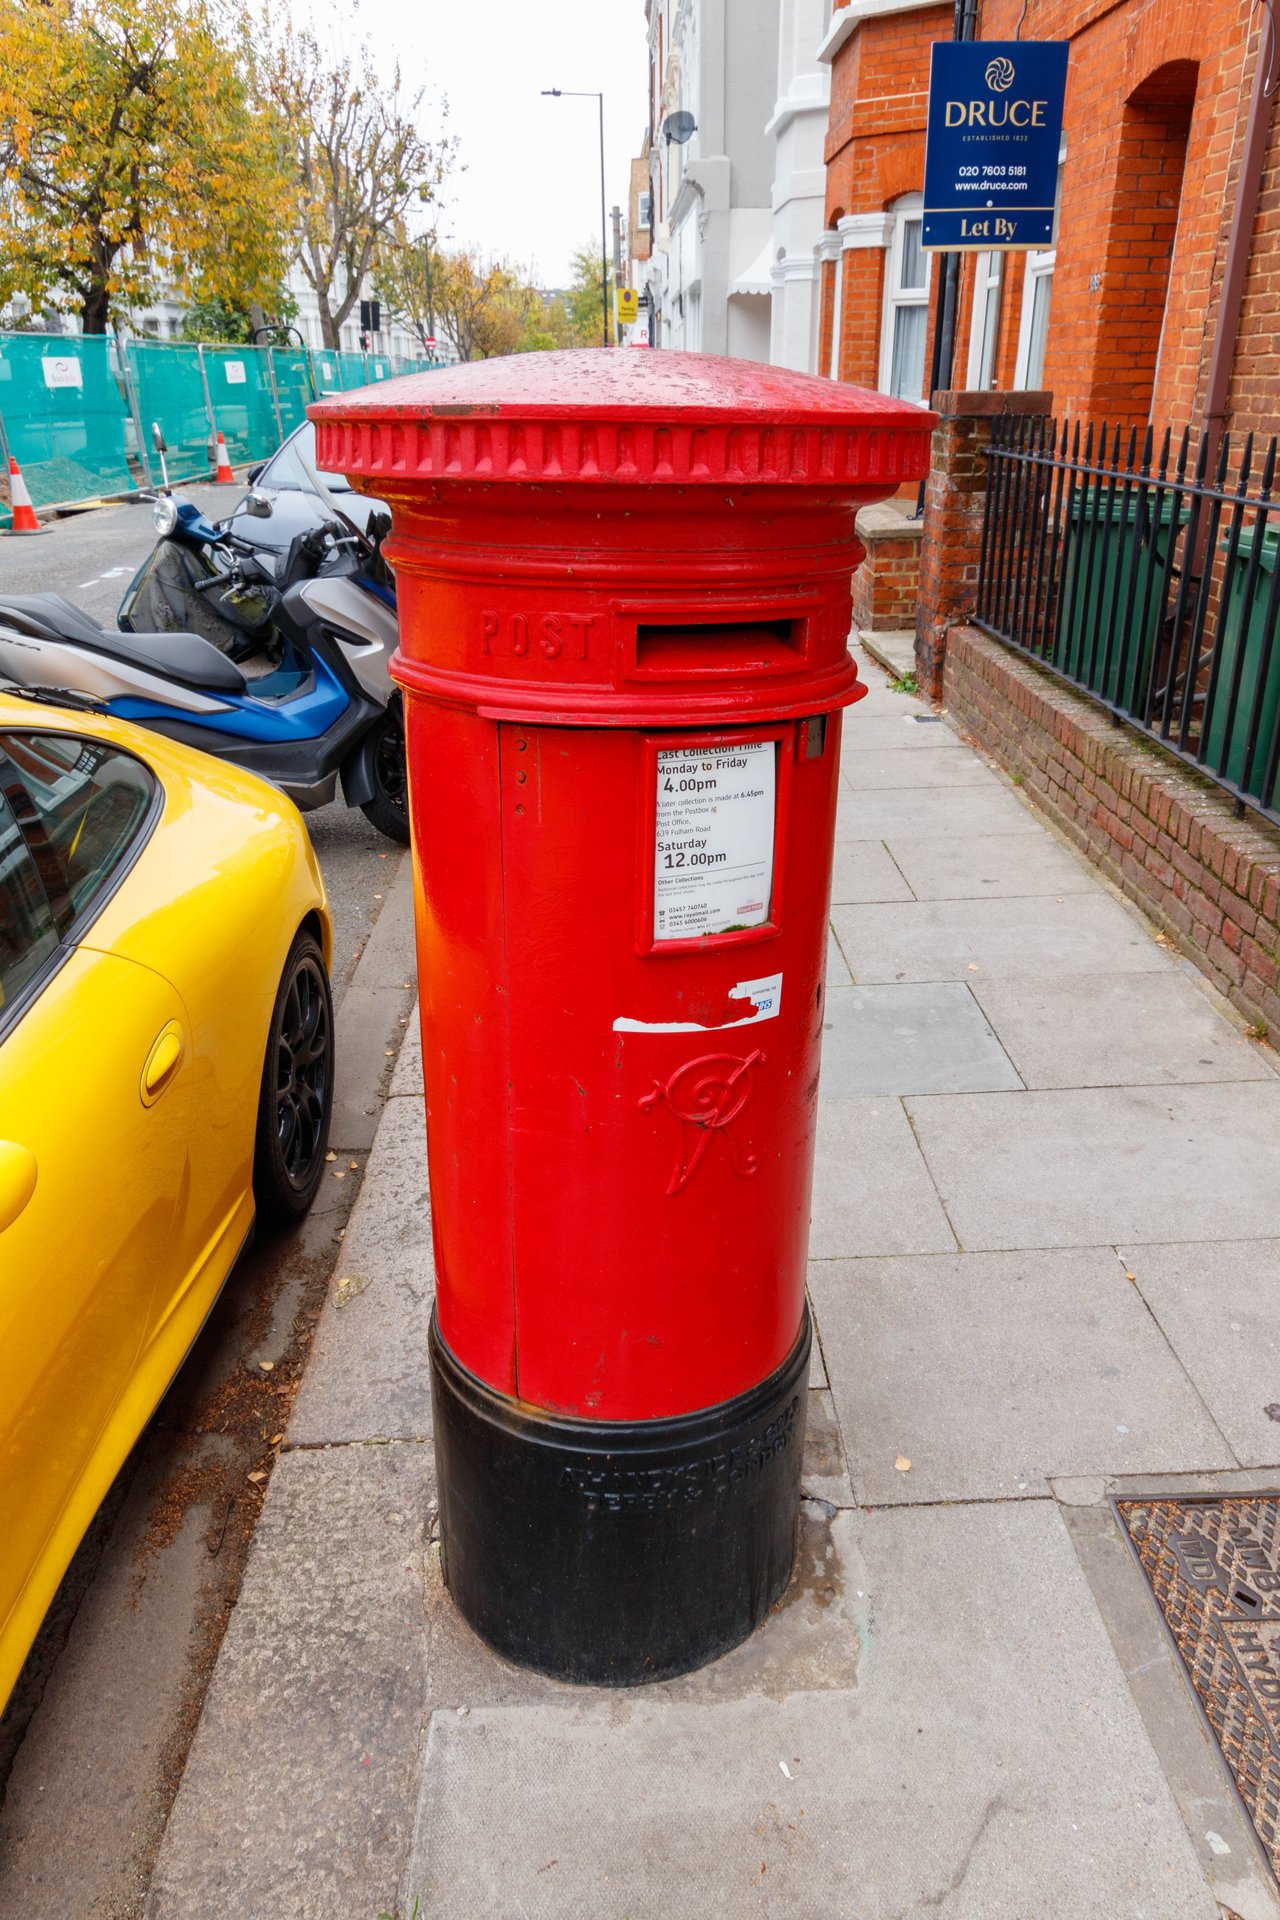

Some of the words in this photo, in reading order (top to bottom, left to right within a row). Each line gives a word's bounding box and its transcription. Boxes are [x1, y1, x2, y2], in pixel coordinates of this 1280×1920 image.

[945, 100, 1049, 128] DRUCE
[958, 166, 979, 177] 020
[982, 165, 1006, 176] 7603
[1008, 165, 1027, 176] 5181
[955, 180, 1028, 191] www.druce.com
[960, 218, 990, 237] Let
[994, 218, 1018, 240] By
[481, 611, 594, 660] POST
[683, 745, 734, 757] Collection
[658, 763, 698, 775] Monday
[701, 762, 713, 771] to
[716, 758, 748, 769] Friday
[664, 777, 717, 793] 4.00pm
[662, 800, 676, 808] later
[678, 796, 707, 806] collection
[715, 793, 732, 801] made
[740, 789, 764, 799] 6.45pm
[673, 809, 684, 817] the
[685, 807, 709, 816] Postbox
[657, 820, 670, 828] Post
[671, 827, 694, 836] Fulham
[695, 825, 711, 833] Road
[657, 838, 707, 852] Saturday
[664, 852, 727, 869] 12.00pm
[675, 875, 704, 884] Collections
[668, 906, 686, 914] 03457
[669, 908, 721, 920] www.royalmail.com
[669, 920, 683, 928] 0345
[1179, 1541, 1215, 1579] WD
